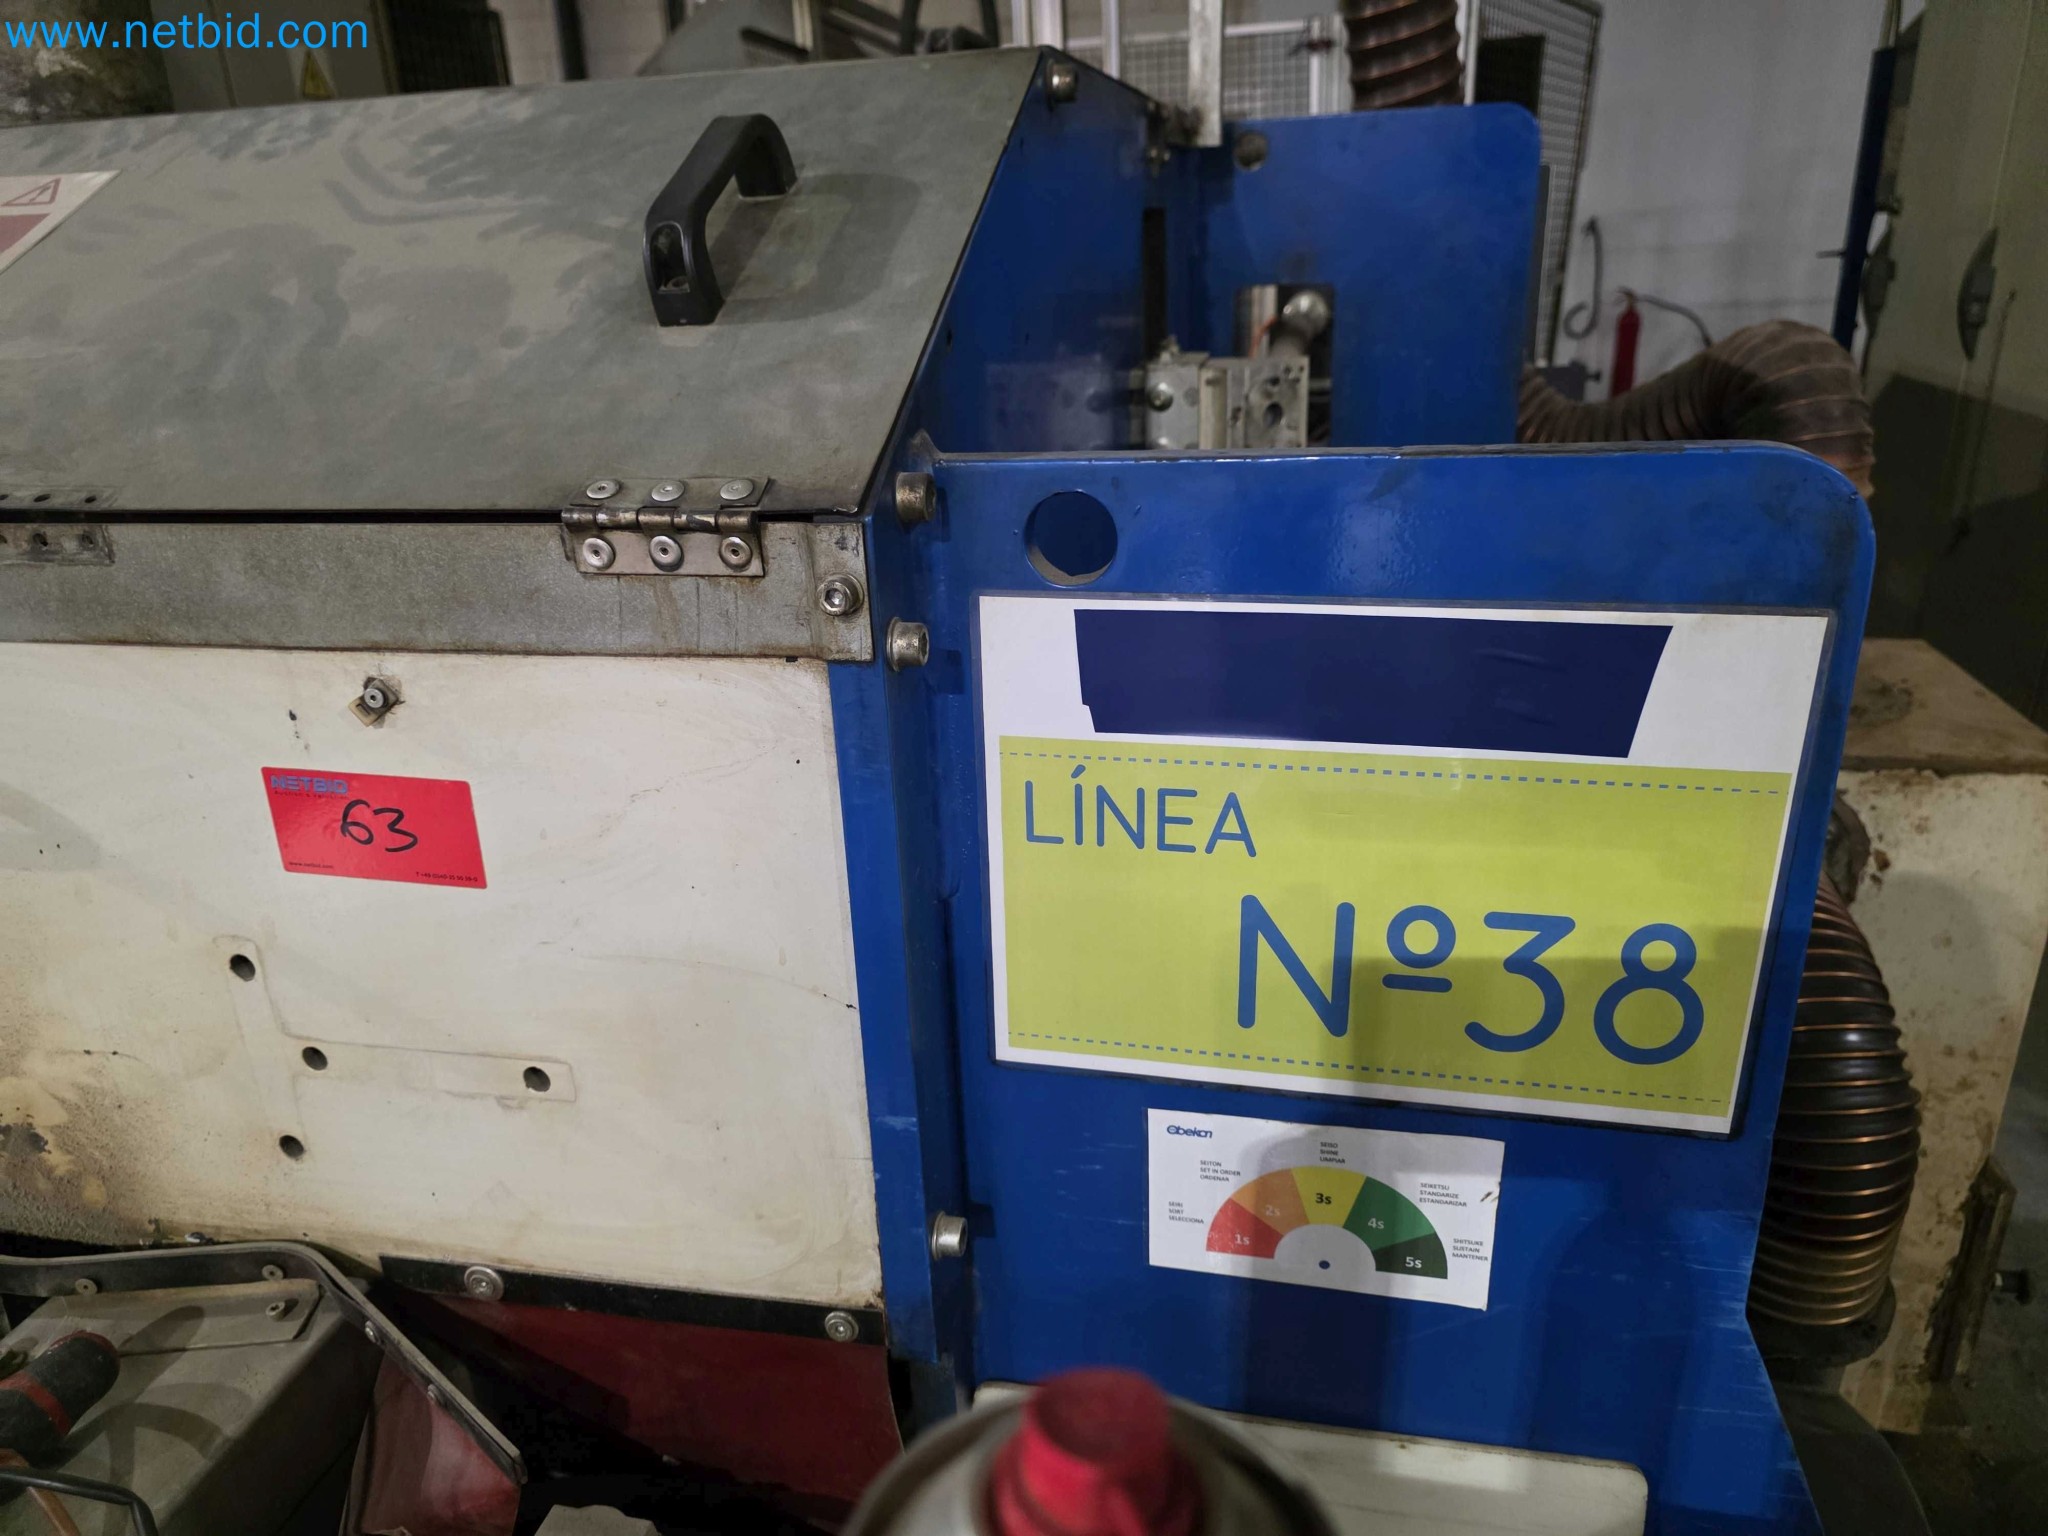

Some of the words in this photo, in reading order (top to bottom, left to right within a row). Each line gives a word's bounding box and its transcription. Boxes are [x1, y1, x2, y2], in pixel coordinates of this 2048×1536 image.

[271, 775, 348, 794] NETBID
[1024, 765, 1257, 858] LÍNEA
[340, 799, 419, 853] 63
[1237, 894, 1705, 1066] Nº38
[1320, 1141, 1338, 1149] SEISO
[1199, 1159, 1222, 1168] SEITON
[1199, 1174, 1230, 1183] ORDENAR
[1219, 1169, 1241, 1177] ORDER
[1420, 1182, 1450, 1191] SEIKETSU
[1315, 1192, 1332, 1205] 3s
[1419, 1189, 1460, 1199] STANDARIZE
[1419, 1197, 1468, 1208] ESTANDARIZAR
[1265, 1204, 1281, 1217] 2s
[1367, 1217, 1385, 1230] 4s
[1234, 1233, 1250, 1246] 1s
[1452, 1245, 1480, 1254] SUSTAIN
[1405, 1256, 1422, 1269] 5s
[1452, 1252, 1489, 1262] MANTENER
